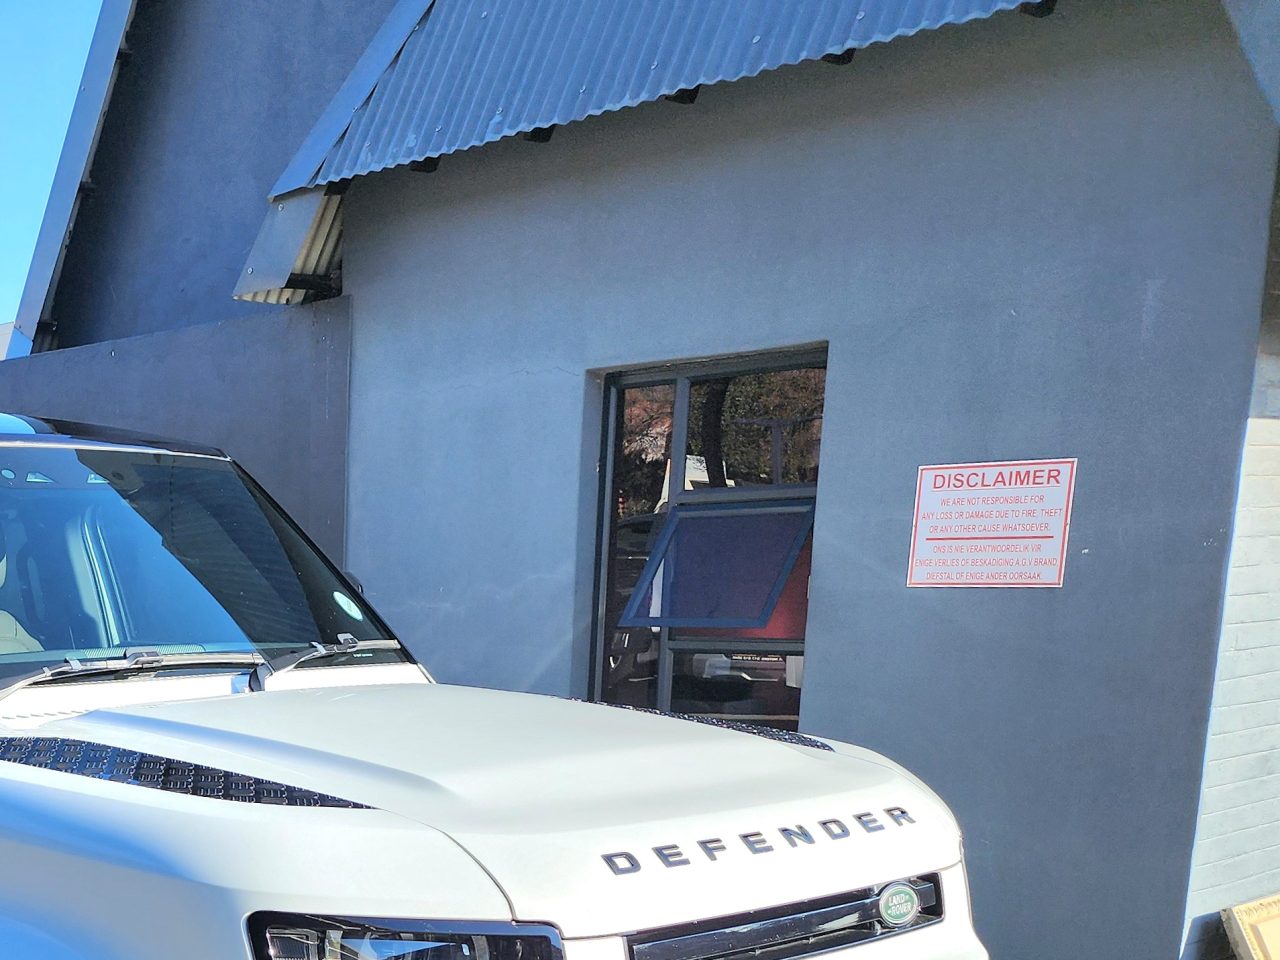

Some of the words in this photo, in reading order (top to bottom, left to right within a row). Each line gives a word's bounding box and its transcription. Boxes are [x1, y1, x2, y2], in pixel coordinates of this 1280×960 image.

[932, 468, 1061, 489] DISCLAIMER
[941, 497, 951, 507] WE
[952, 496, 966, 506] ARE
[967, 496, 980, 506] NOT
[982, 495, 1029, 505] RESPONSIBLE
[1030, 494, 1045, 504] FOR
[921, 511, 935, 520] ANY
[936, 511, 953, 520] LOSS
[954, 511, 964, 520] OR
[965, 510, 994, 519] DAMAGE
[995, 509, 1009, 519] DUE
[1011, 509, 1020, 518] TO
[1041, 507, 1063, 517] THEFT
[929, 525, 939, 534] OR
[940, 524, 953, 533] ANY
[954, 524, 977, 533] OTHER
[977, 523, 1001, 533] CAUSE
[965, 543, 1030, 553] VERANTWOORDELIK
[1030, 543, 1042, 552] VIR
[934, 558, 960, 567] VERLIES
[960, 558, 970, 567] OF
[970, 558, 1014, 567] BESKADIGING
[926, 571, 955, 580] DIEFSTAL
[955, 571, 965, 580] OF
[965, 571, 985, 580] ENIGE
[985, 571, 1008, 580] ANDER
[601, 806, 917, 875] DEFENDER
[888, 893, 906, 907] LAND
[890, 902, 912, 916] ROVER
